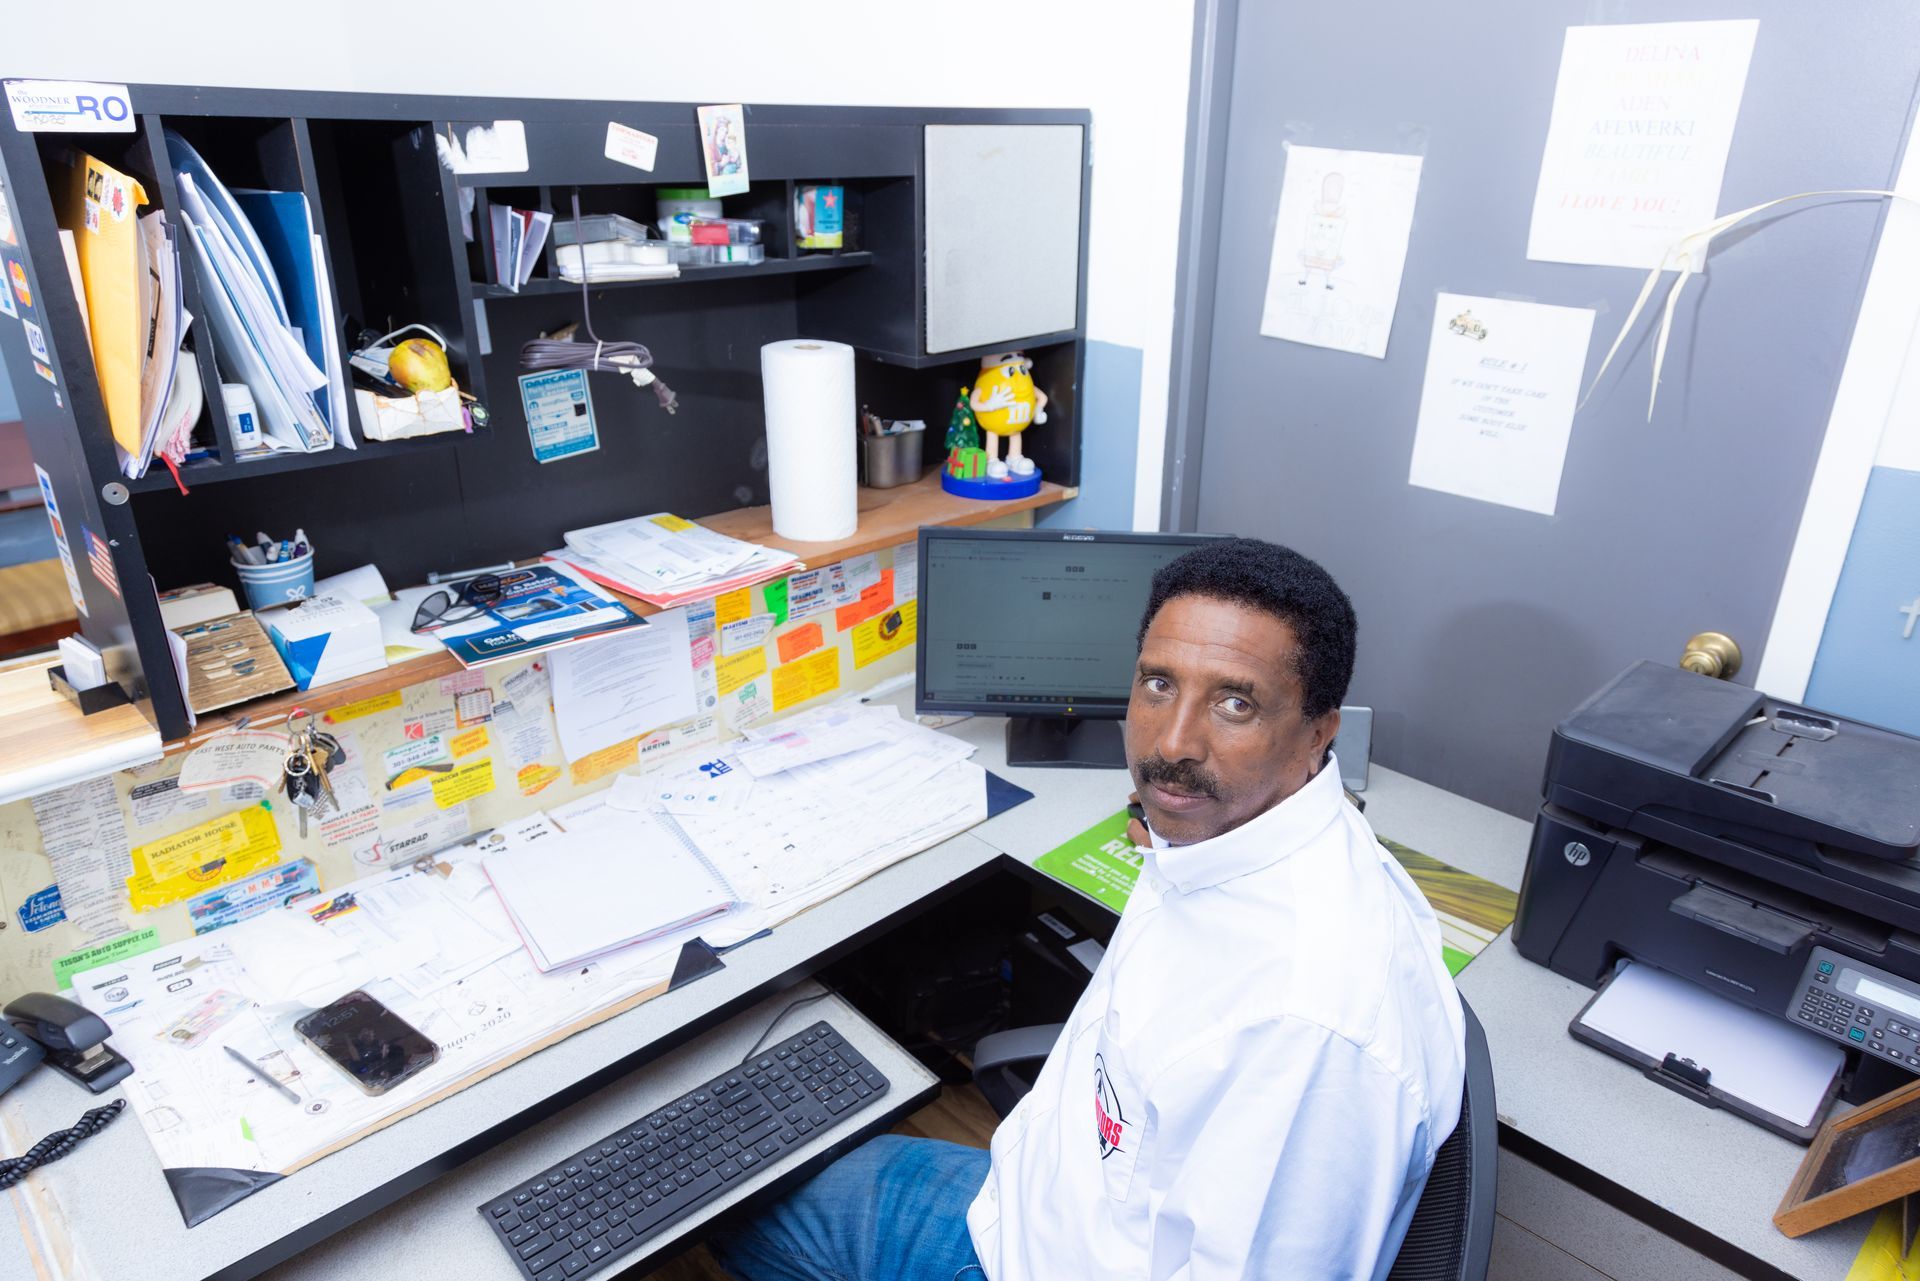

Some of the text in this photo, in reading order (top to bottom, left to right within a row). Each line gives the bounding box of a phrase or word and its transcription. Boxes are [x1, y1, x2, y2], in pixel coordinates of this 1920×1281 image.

[1624, 45, 1701, 64] DELINA
[11, 95, 71, 105] WOODNER
[75, 95, 128, 122] RO
[1589, 119, 1696, 137] AFEWERKI
[1572, 193, 1626, 210] LOVE
[214, 744, 234, 753] WEST
[235, 743, 256, 751] AUTO
[258, 744, 285, 756] PARTS
[150, 821, 238, 860] RADIATOR HOUSE
[389, 832, 429, 853] STARRAD
[1567, 843, 1587, 865] hp
[91, 945, 112, 958] AUTO
[480, 1011, 511, 1031] 2020
